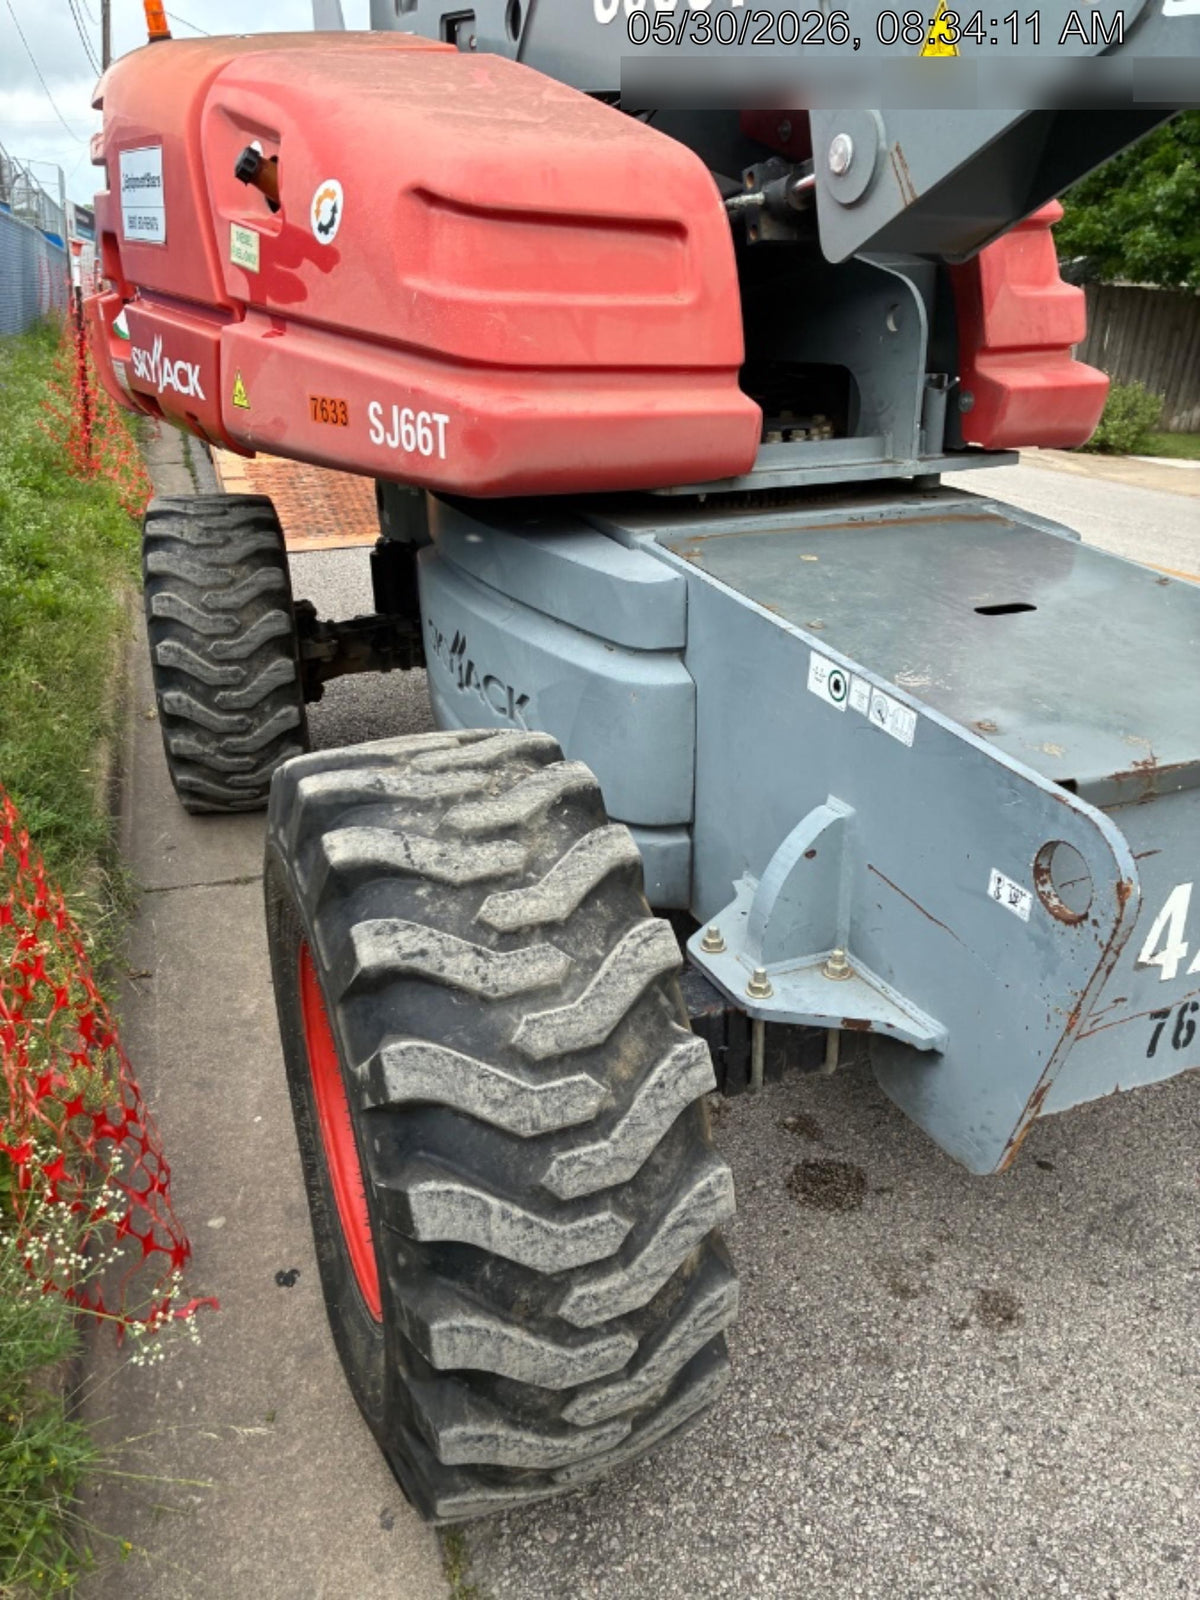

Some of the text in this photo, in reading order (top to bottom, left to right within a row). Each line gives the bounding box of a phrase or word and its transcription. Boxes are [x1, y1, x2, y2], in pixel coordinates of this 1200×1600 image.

[132, 334, 206, 400] SKYJACK
[310, 397, 348, 427] 7633
[368, 400, 450, 460] SJ66T
